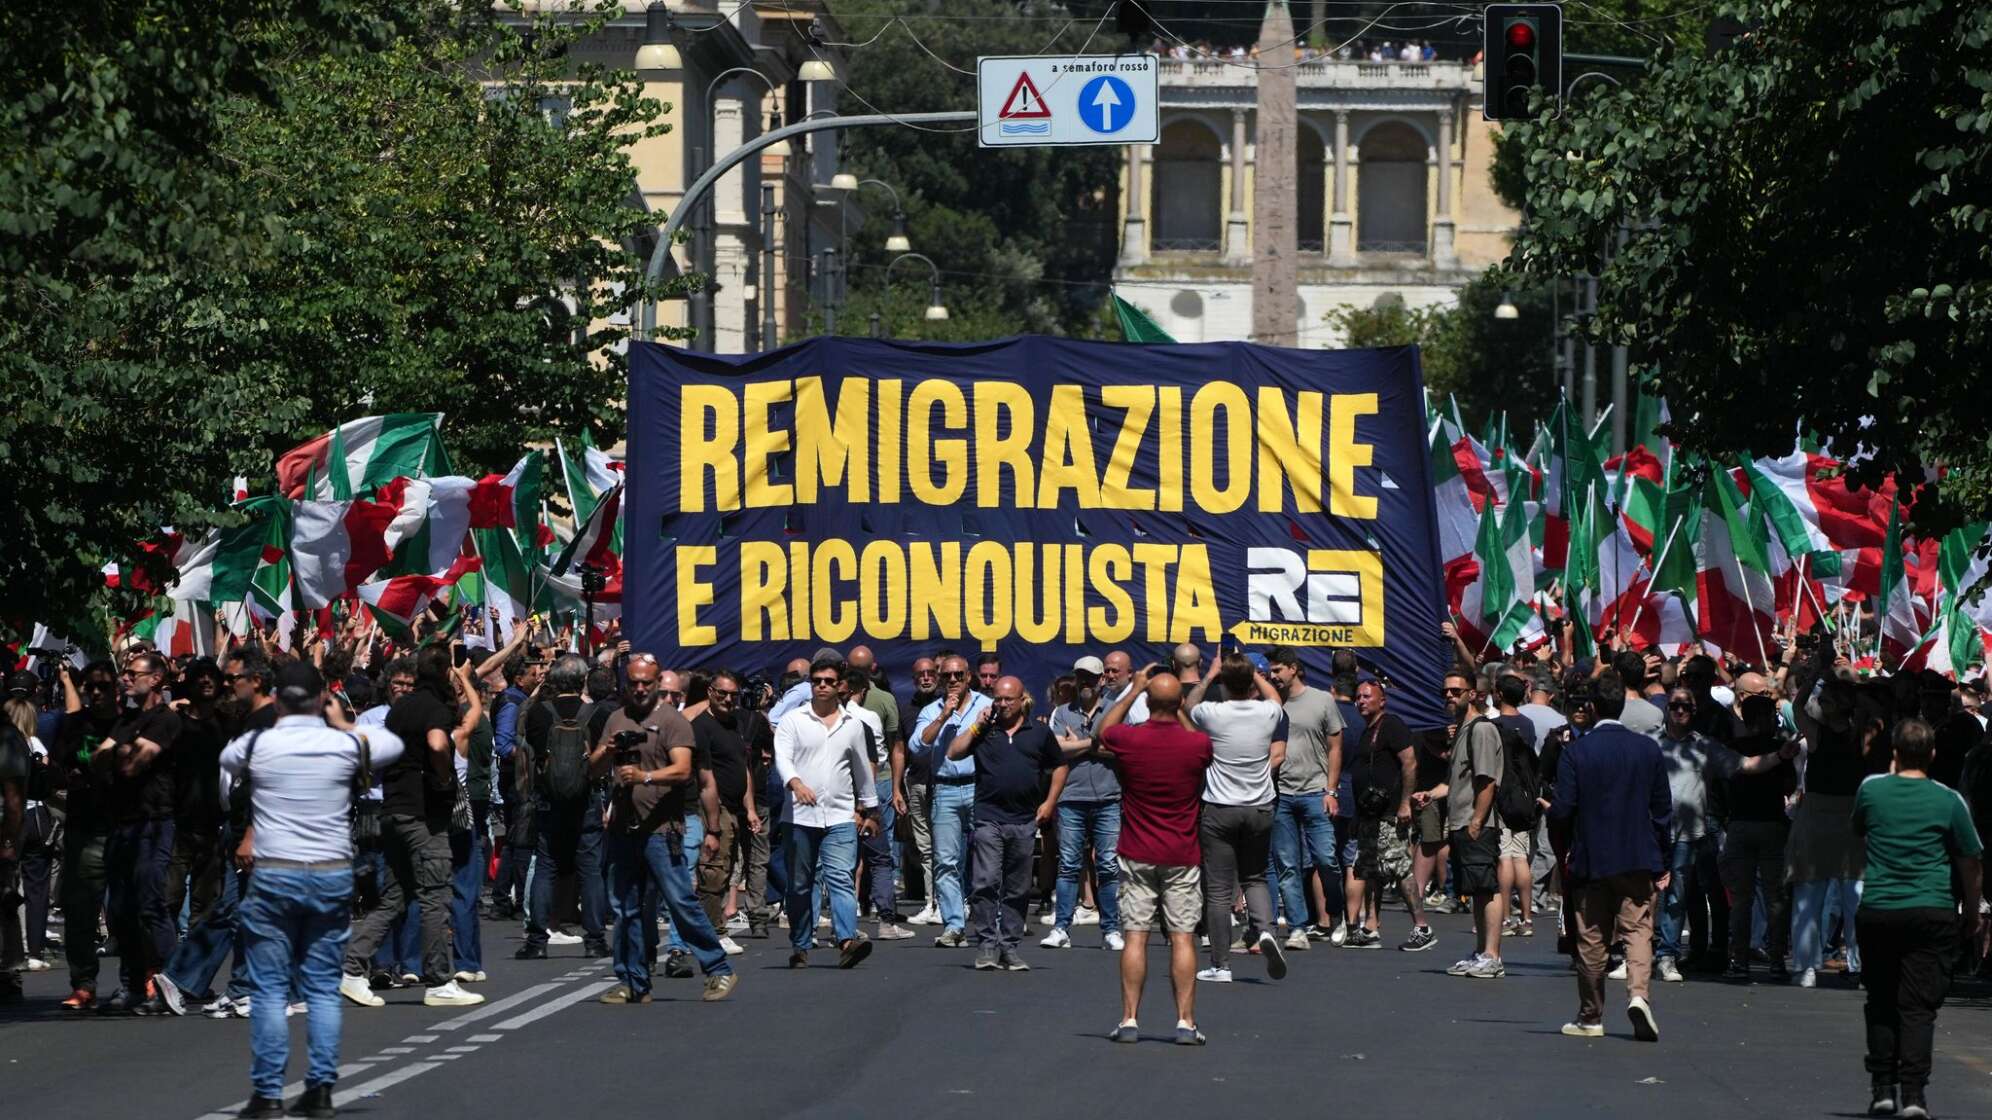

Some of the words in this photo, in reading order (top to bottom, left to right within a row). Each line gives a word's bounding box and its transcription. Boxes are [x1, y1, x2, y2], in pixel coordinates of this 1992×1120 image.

[1052, 64, 1058, 73] a
[1064, 61, 1115, 73] semaforo
[1120, 62, 1149, 72] rosso
[680, 376, 1379, 519] REMIGRAZIONE
[676, 546, 717, 647] E
[741, 538, 1223, 653] RICONQUISTA
[1248, 547, 1361, 623] RE
[1250, 626, 1353, 642] MIGRAZIONE
